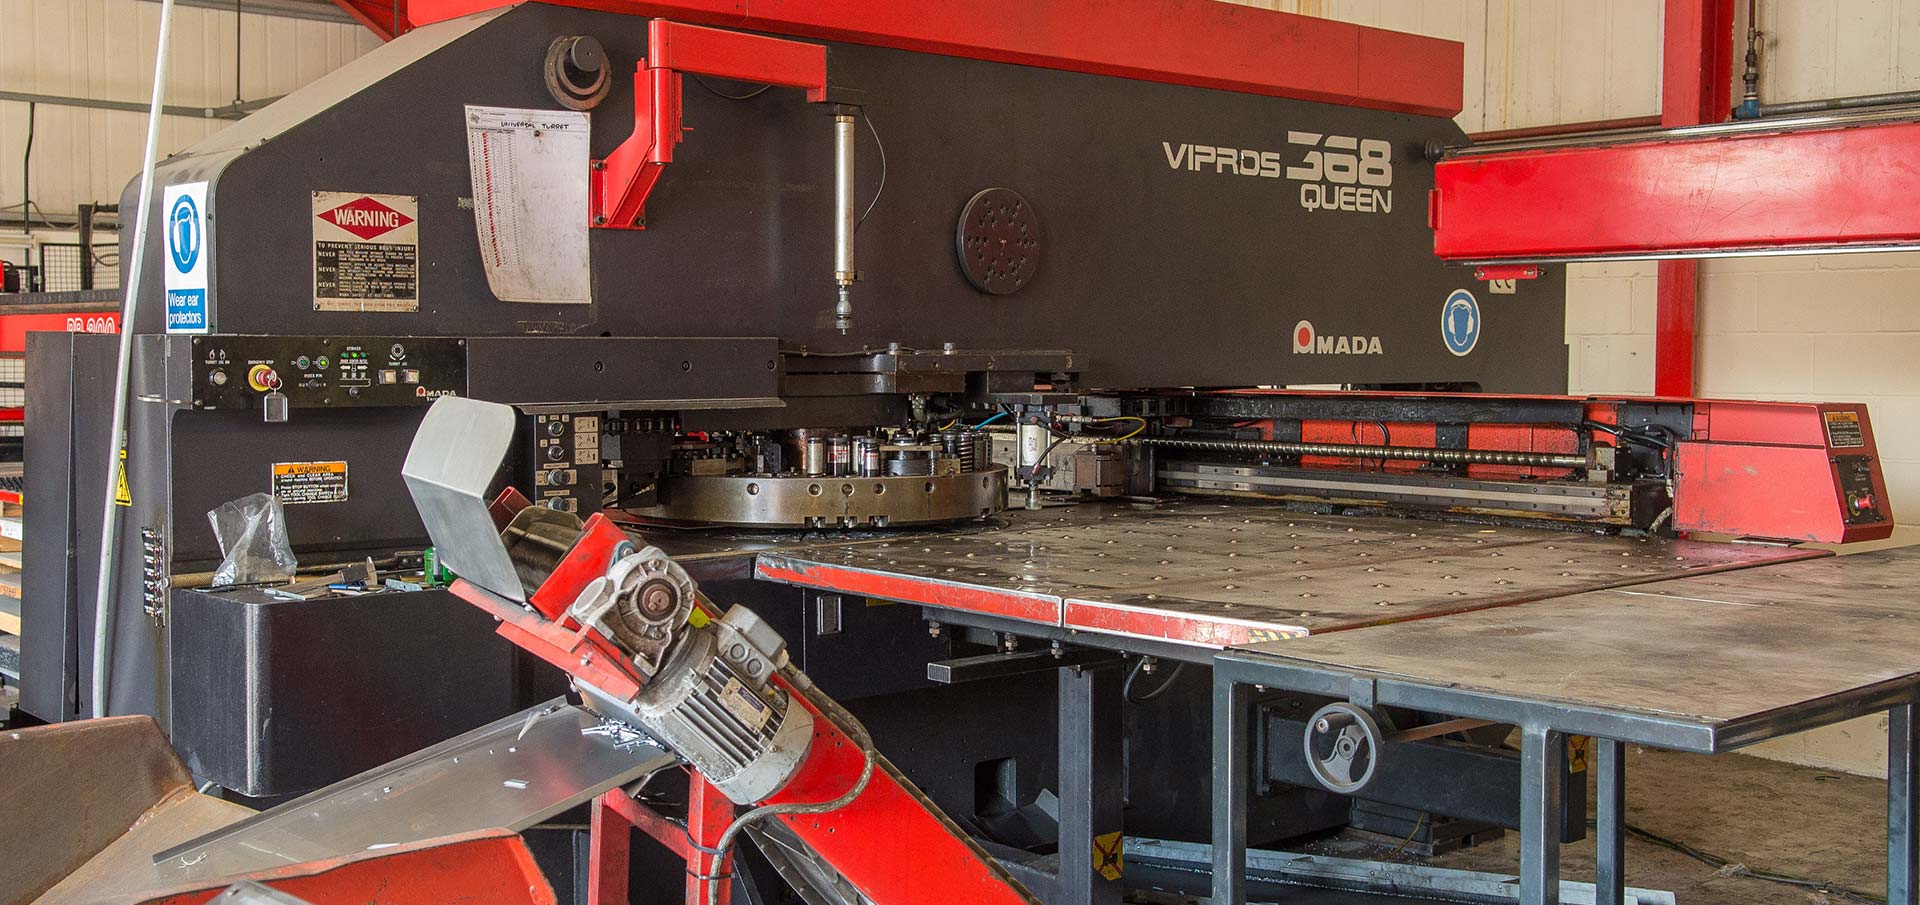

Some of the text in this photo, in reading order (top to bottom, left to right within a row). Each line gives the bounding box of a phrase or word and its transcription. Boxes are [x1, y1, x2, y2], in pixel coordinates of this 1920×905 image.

[1162, 130, 1392, 187] VIPROS 368
[1300, 184, 1392, 214] QUEEN
[334, 208, 399, 227] WARNING
[168, 293, 199, 306] Wear ear
[169, 311, 201, 327] protectors
[1293, 320, 1383, 355] AMADA
